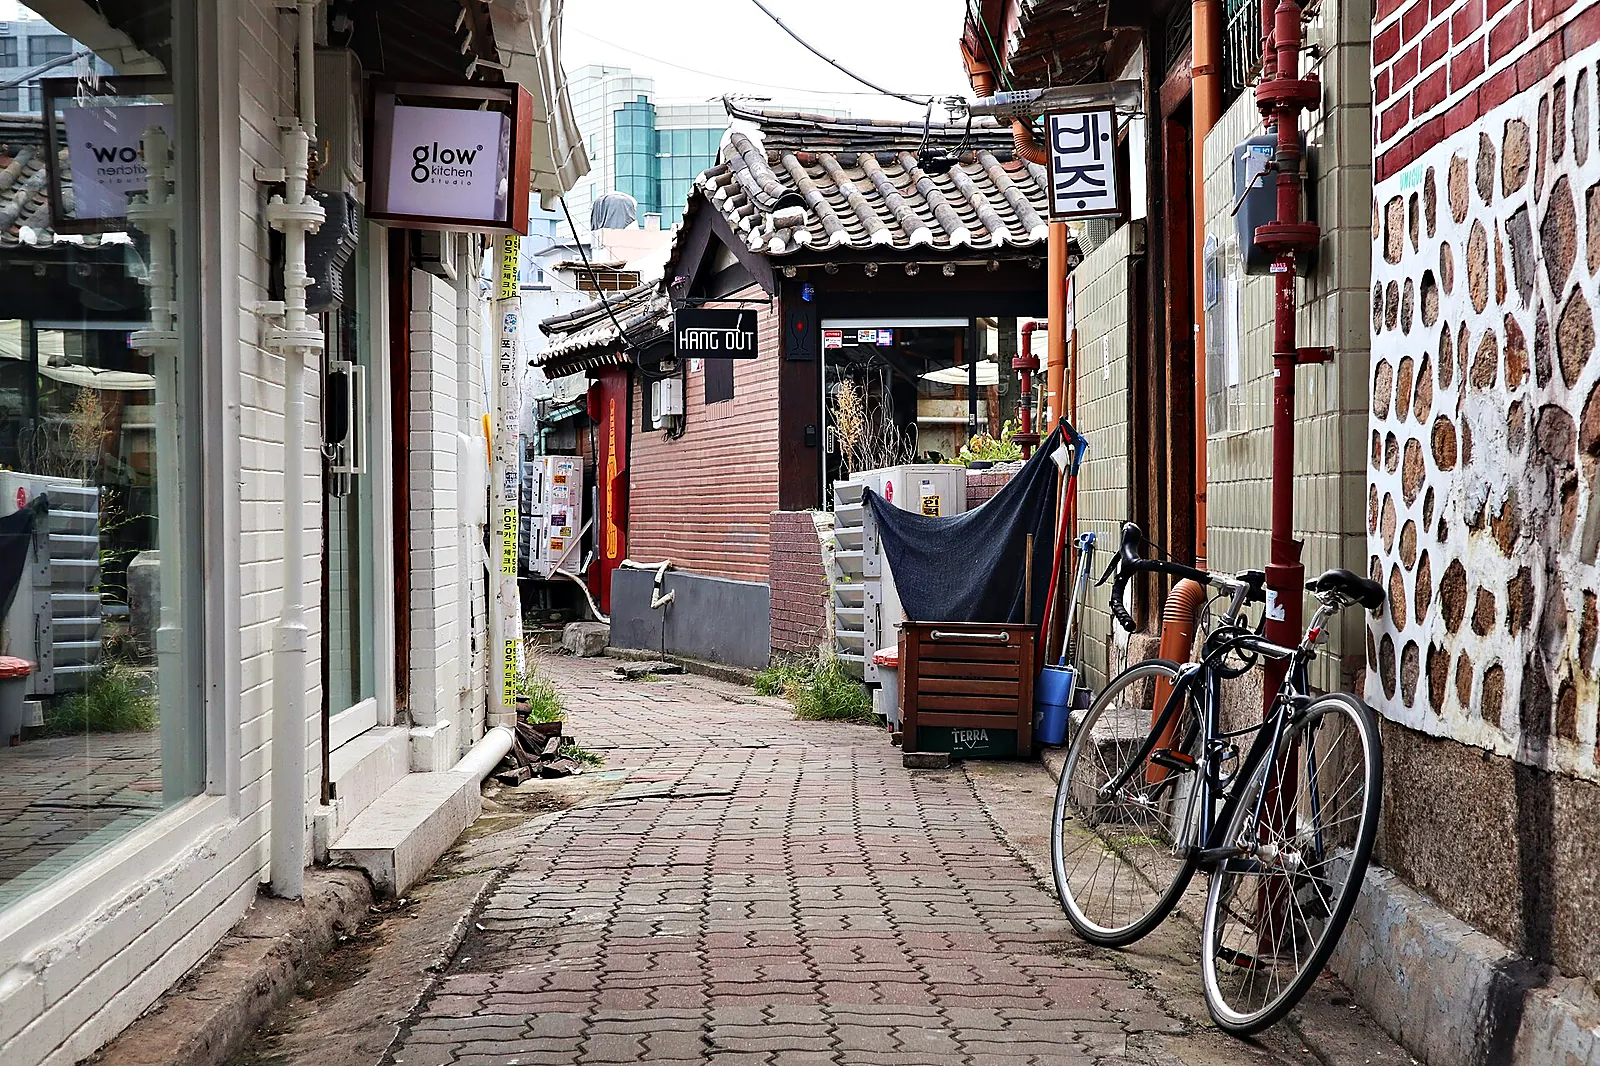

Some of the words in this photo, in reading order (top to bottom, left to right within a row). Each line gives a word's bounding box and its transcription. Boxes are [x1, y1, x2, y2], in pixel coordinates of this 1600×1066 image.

[431, 165, 473, 178] kitchen
[679, 329, 719, 350] HANG
[725, 331, 754, 350] OUT
[951, 728, 989, 744] TERRA
